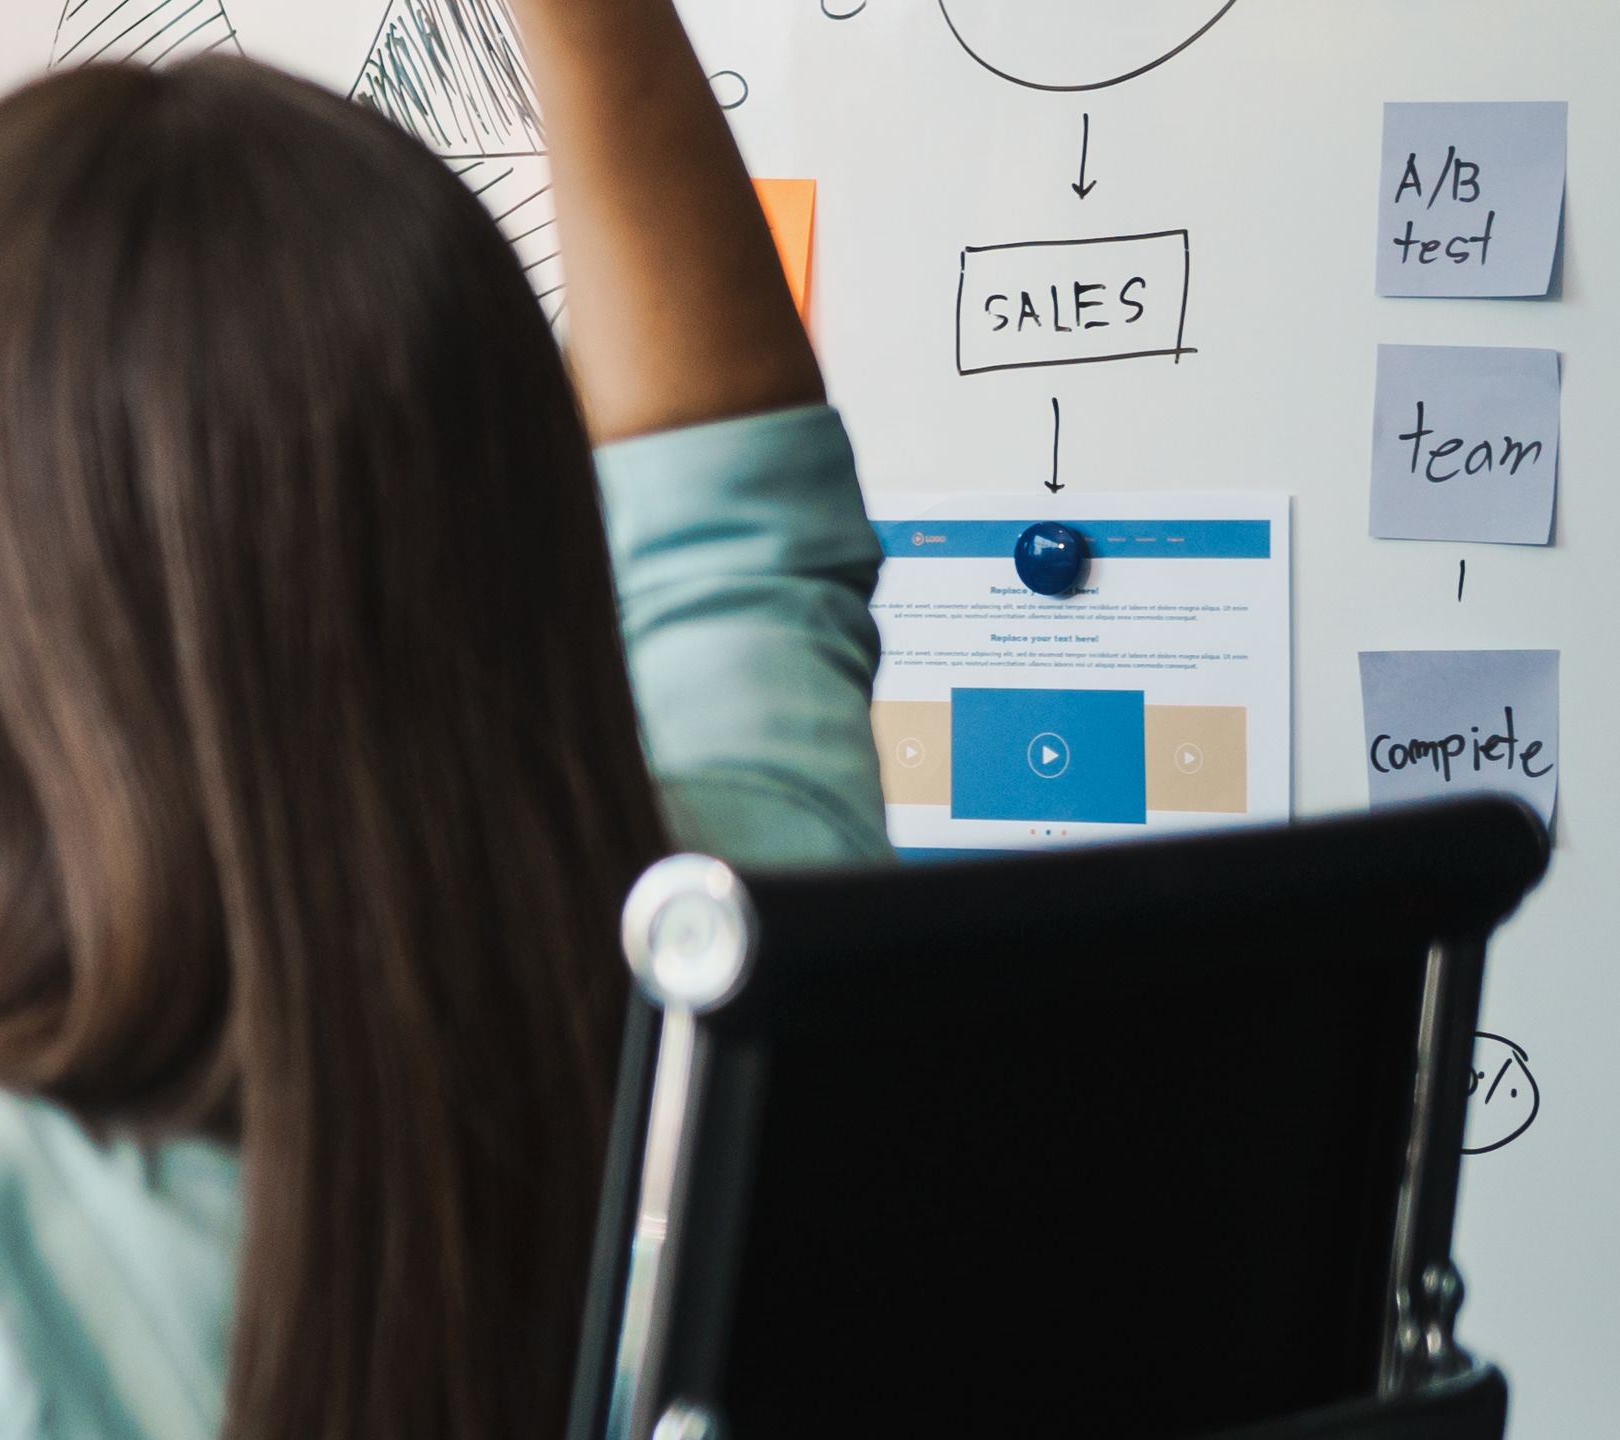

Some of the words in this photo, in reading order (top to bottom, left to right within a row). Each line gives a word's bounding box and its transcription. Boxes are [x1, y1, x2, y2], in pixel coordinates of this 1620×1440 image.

[1395, 145, 1480, 210] A/B
[1393, 210, 1495, 265] test
[984, 276, 1147, 334] SALES
[1398, 401, 1542, 483] team
